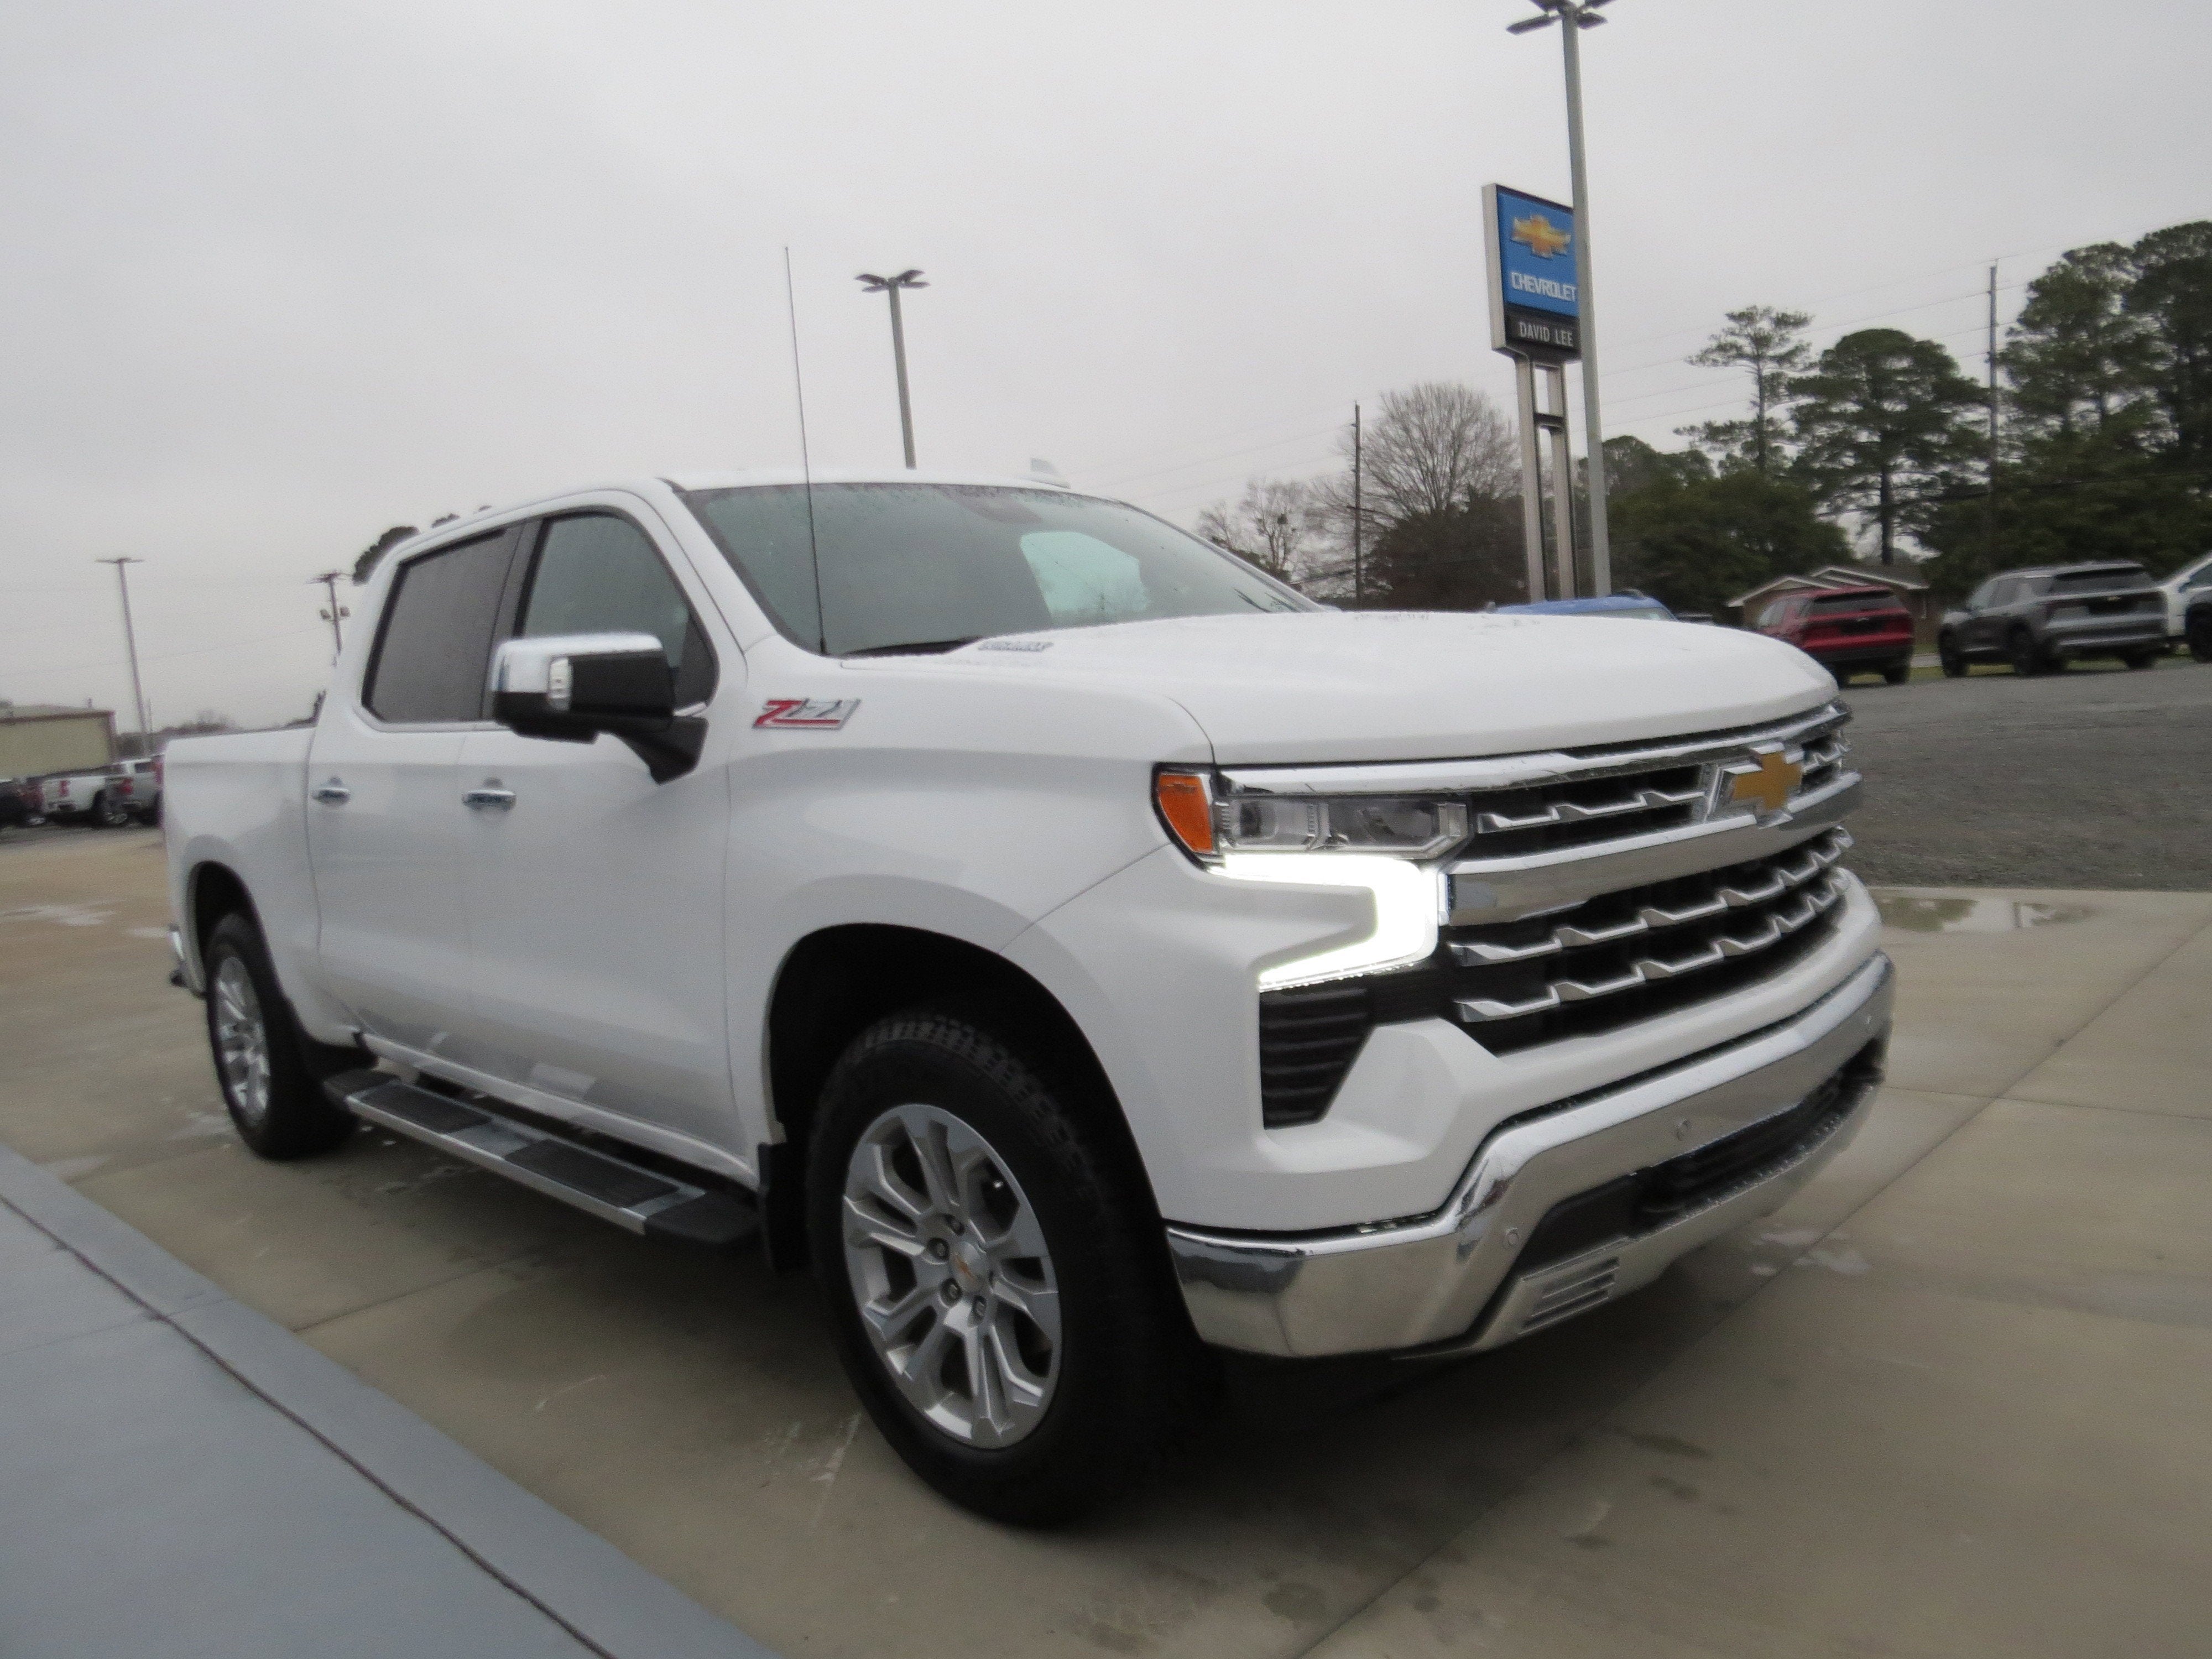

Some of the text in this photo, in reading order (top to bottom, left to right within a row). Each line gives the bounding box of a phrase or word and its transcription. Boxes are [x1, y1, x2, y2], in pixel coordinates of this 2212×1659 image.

[1511, 272, 1576, 302] CHEVROLET
[1519, 322, 1573, 347] DAVID LEE
